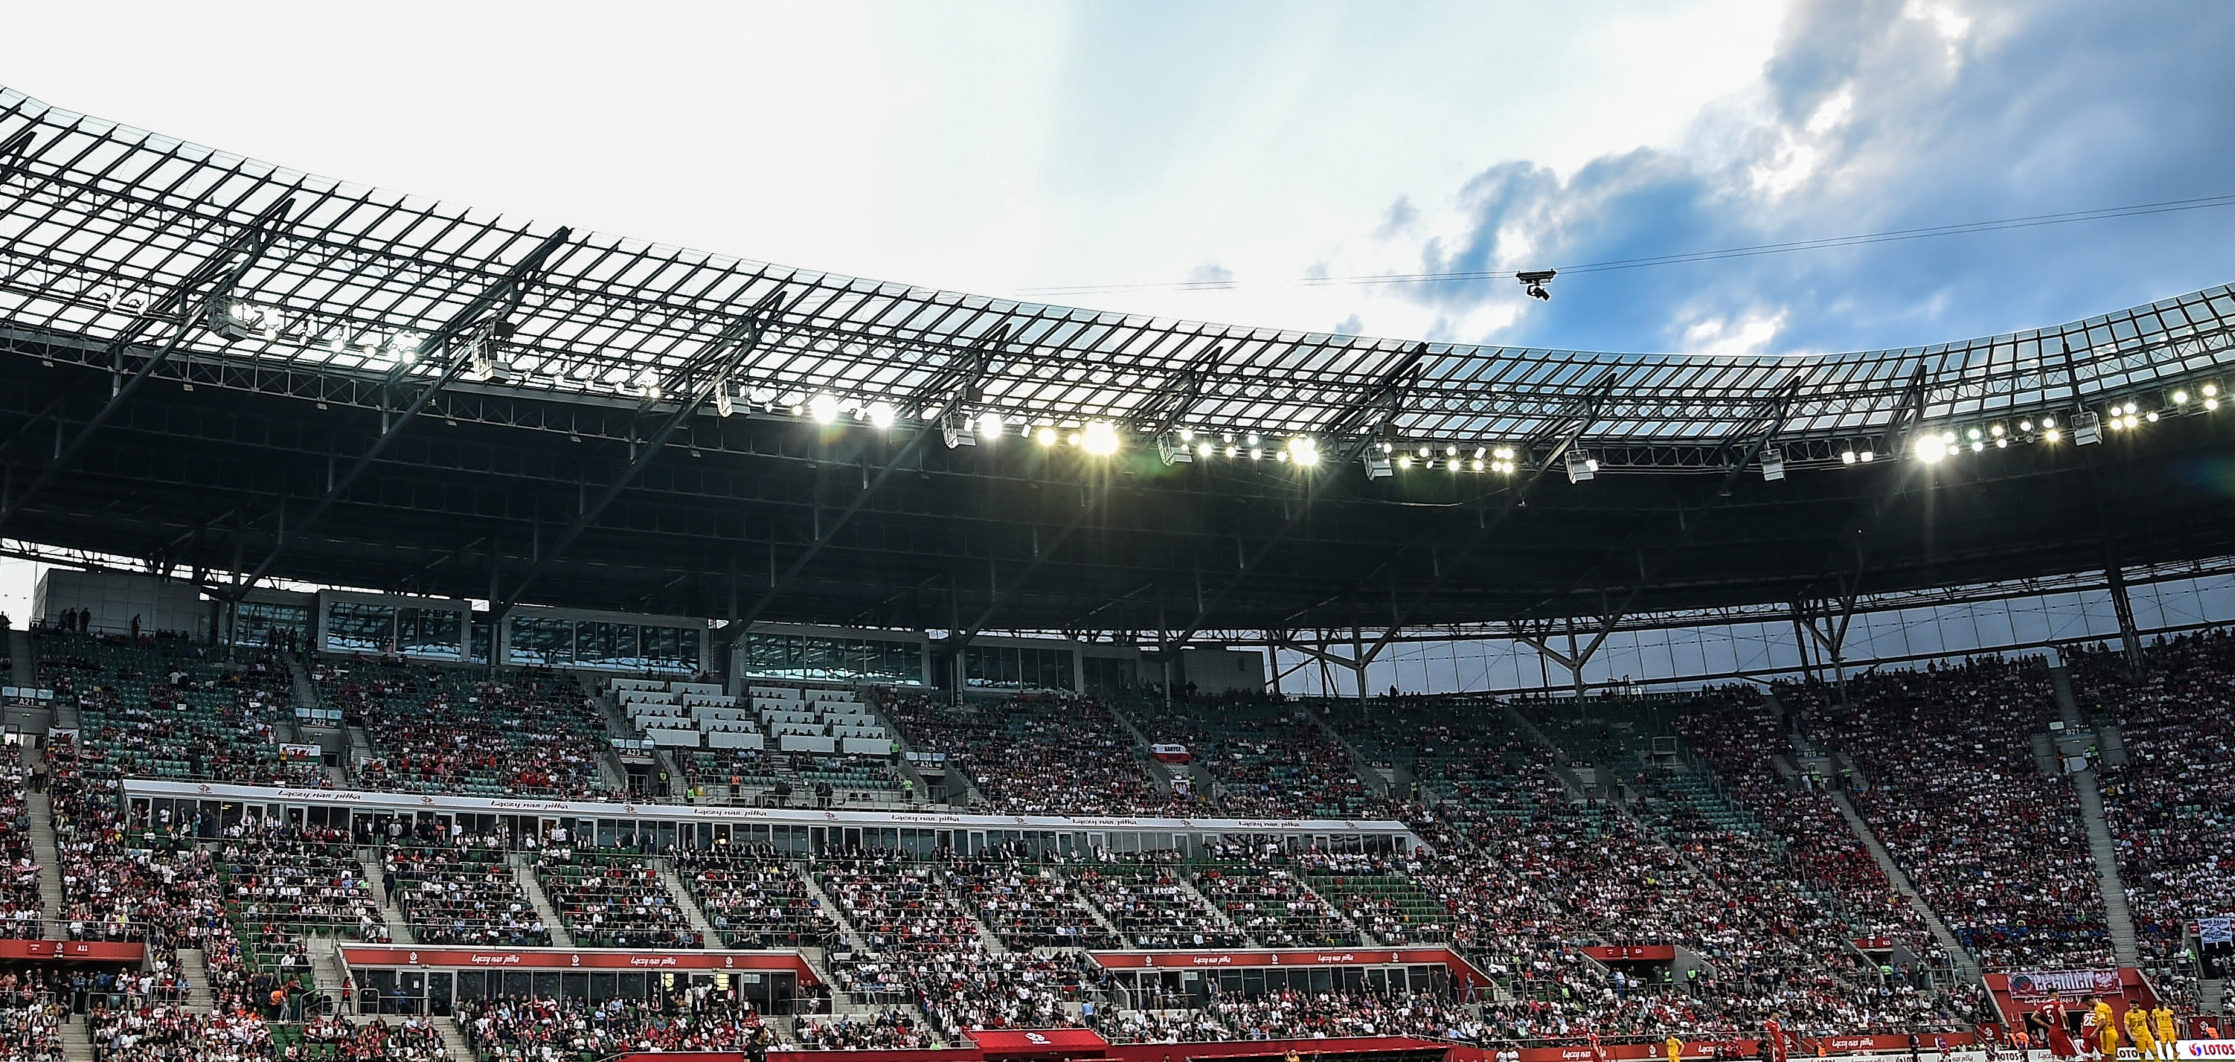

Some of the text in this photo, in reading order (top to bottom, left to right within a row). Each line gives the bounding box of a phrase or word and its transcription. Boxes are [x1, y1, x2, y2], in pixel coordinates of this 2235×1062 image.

[19, 698, 34, 706] A21
[2203, 1044, 2235, 1055] LOTOS
[2115, 1050, 2138, 1058] LOTO
